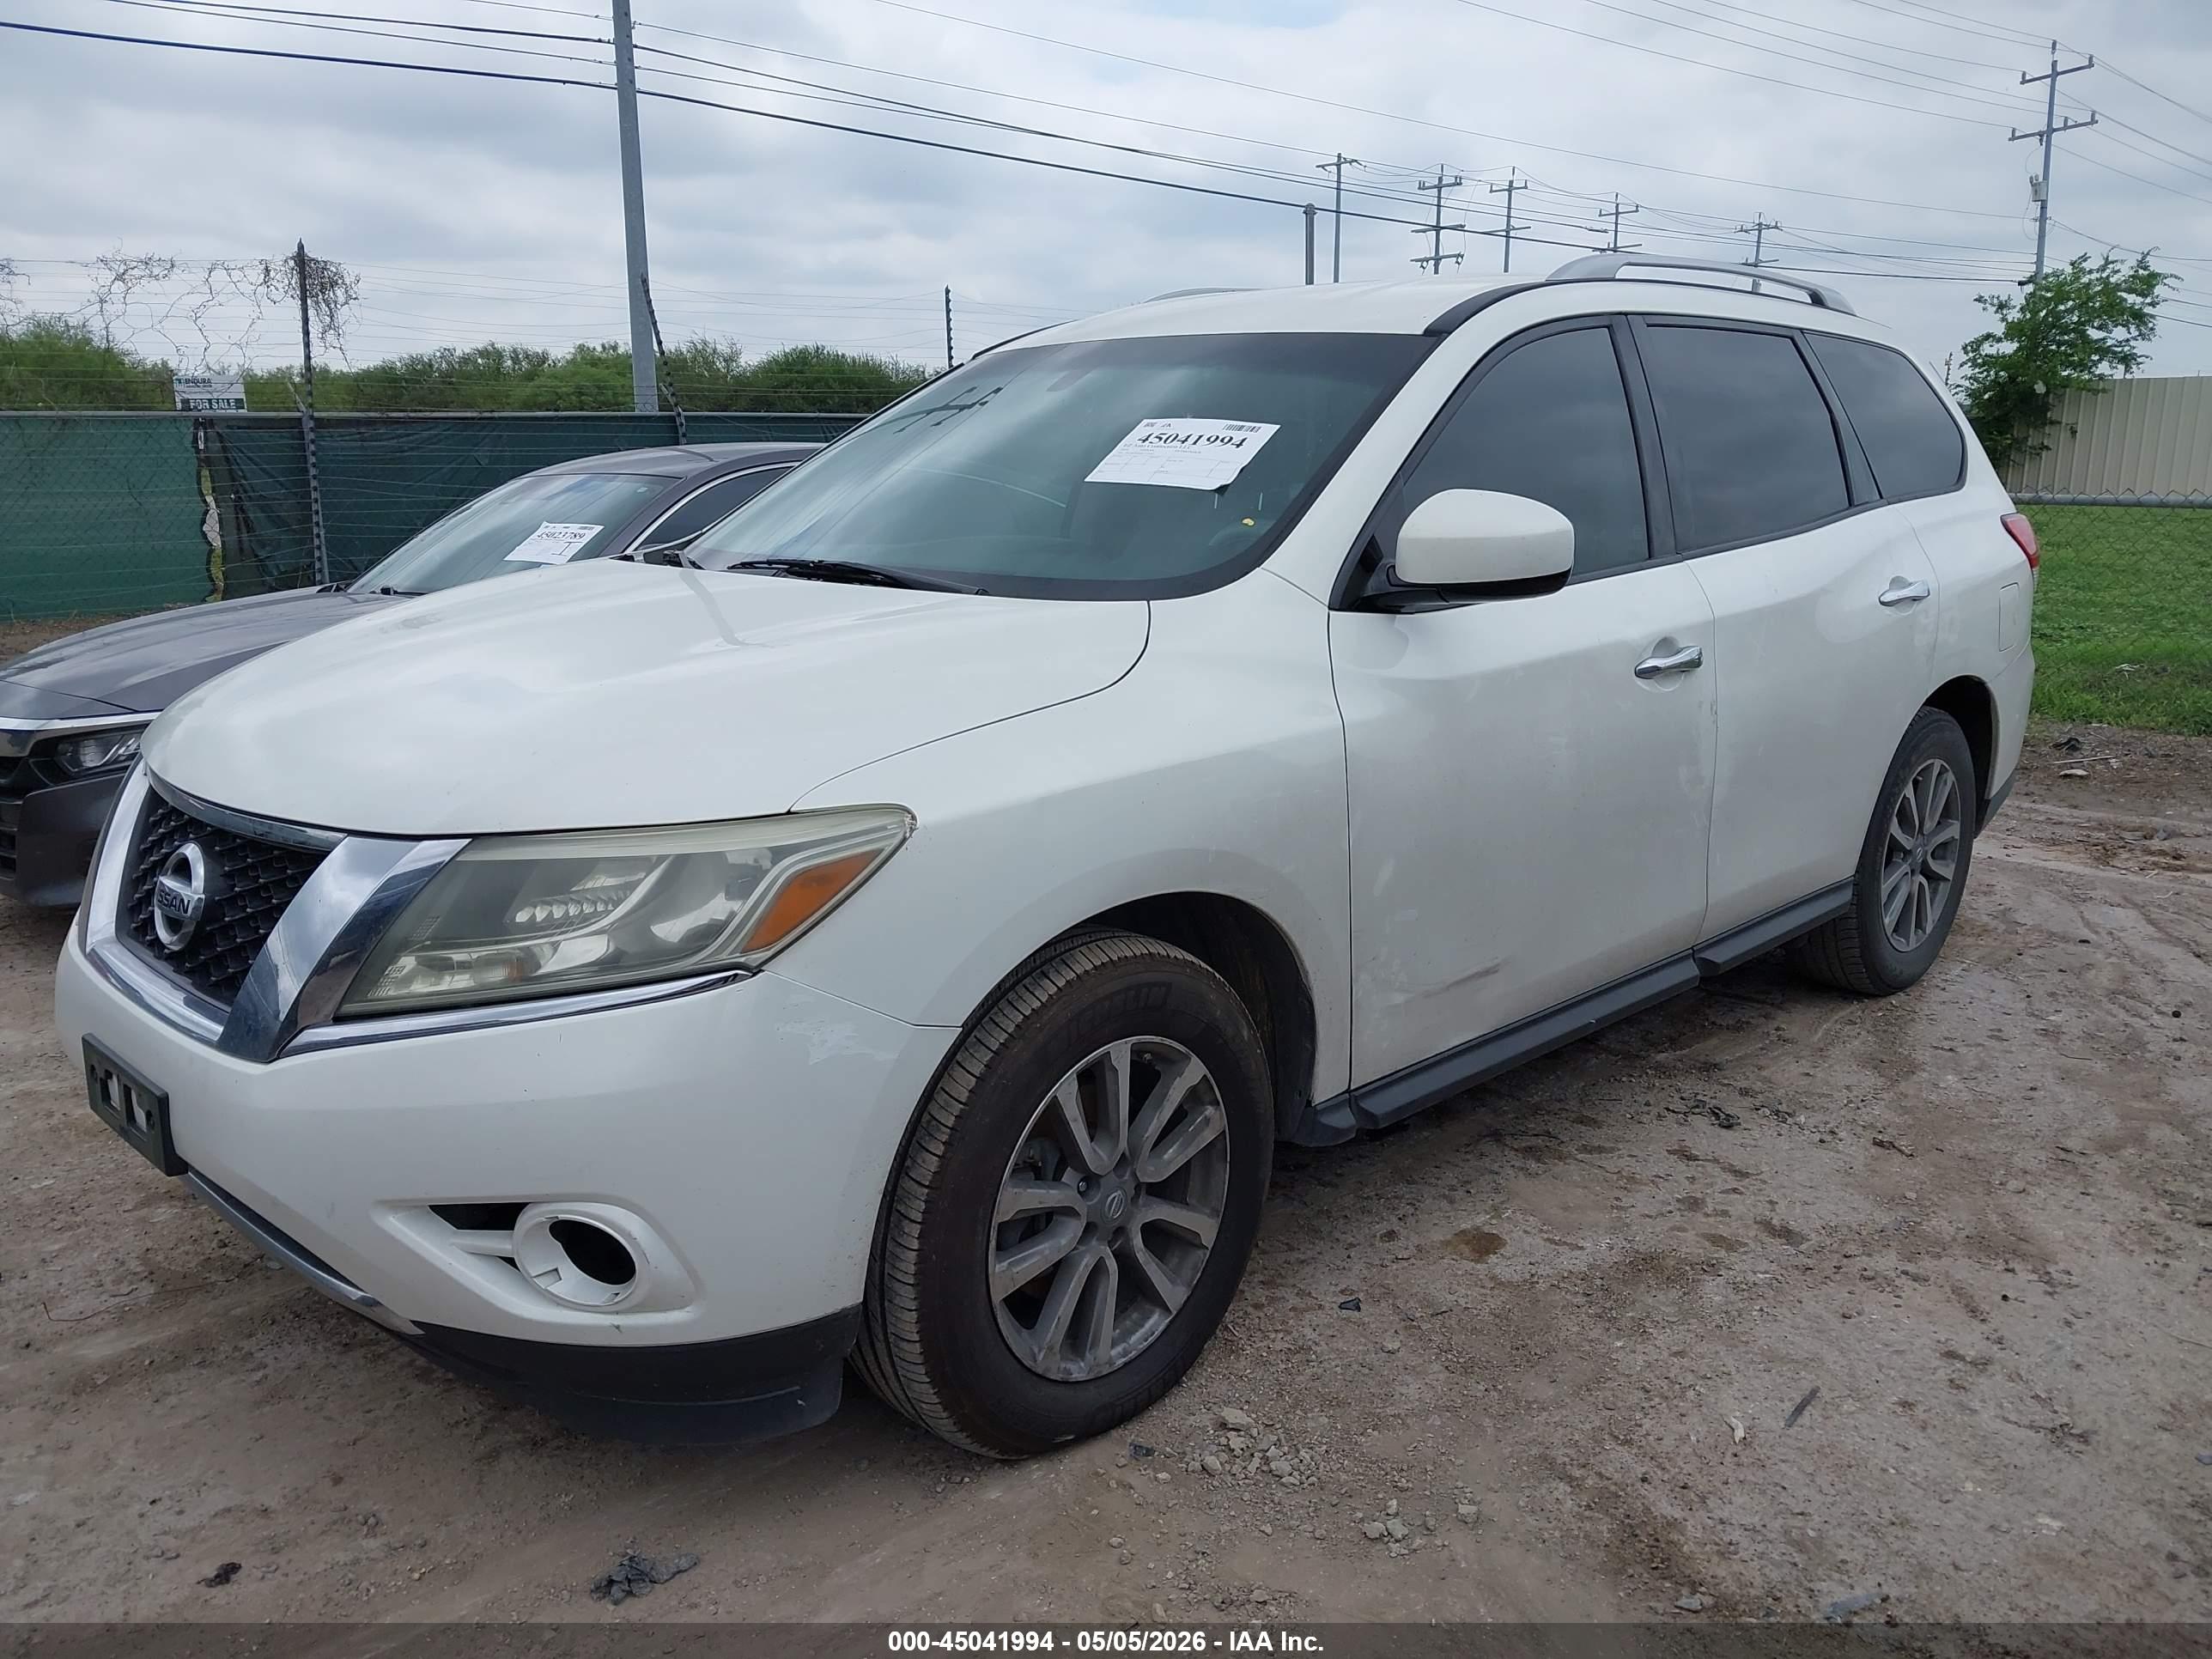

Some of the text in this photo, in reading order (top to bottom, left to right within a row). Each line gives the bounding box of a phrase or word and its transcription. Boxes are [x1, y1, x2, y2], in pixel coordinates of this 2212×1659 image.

[189, 398, 236, 410] FOR SALE
[1136, 432, 1249, 449] 45041994
